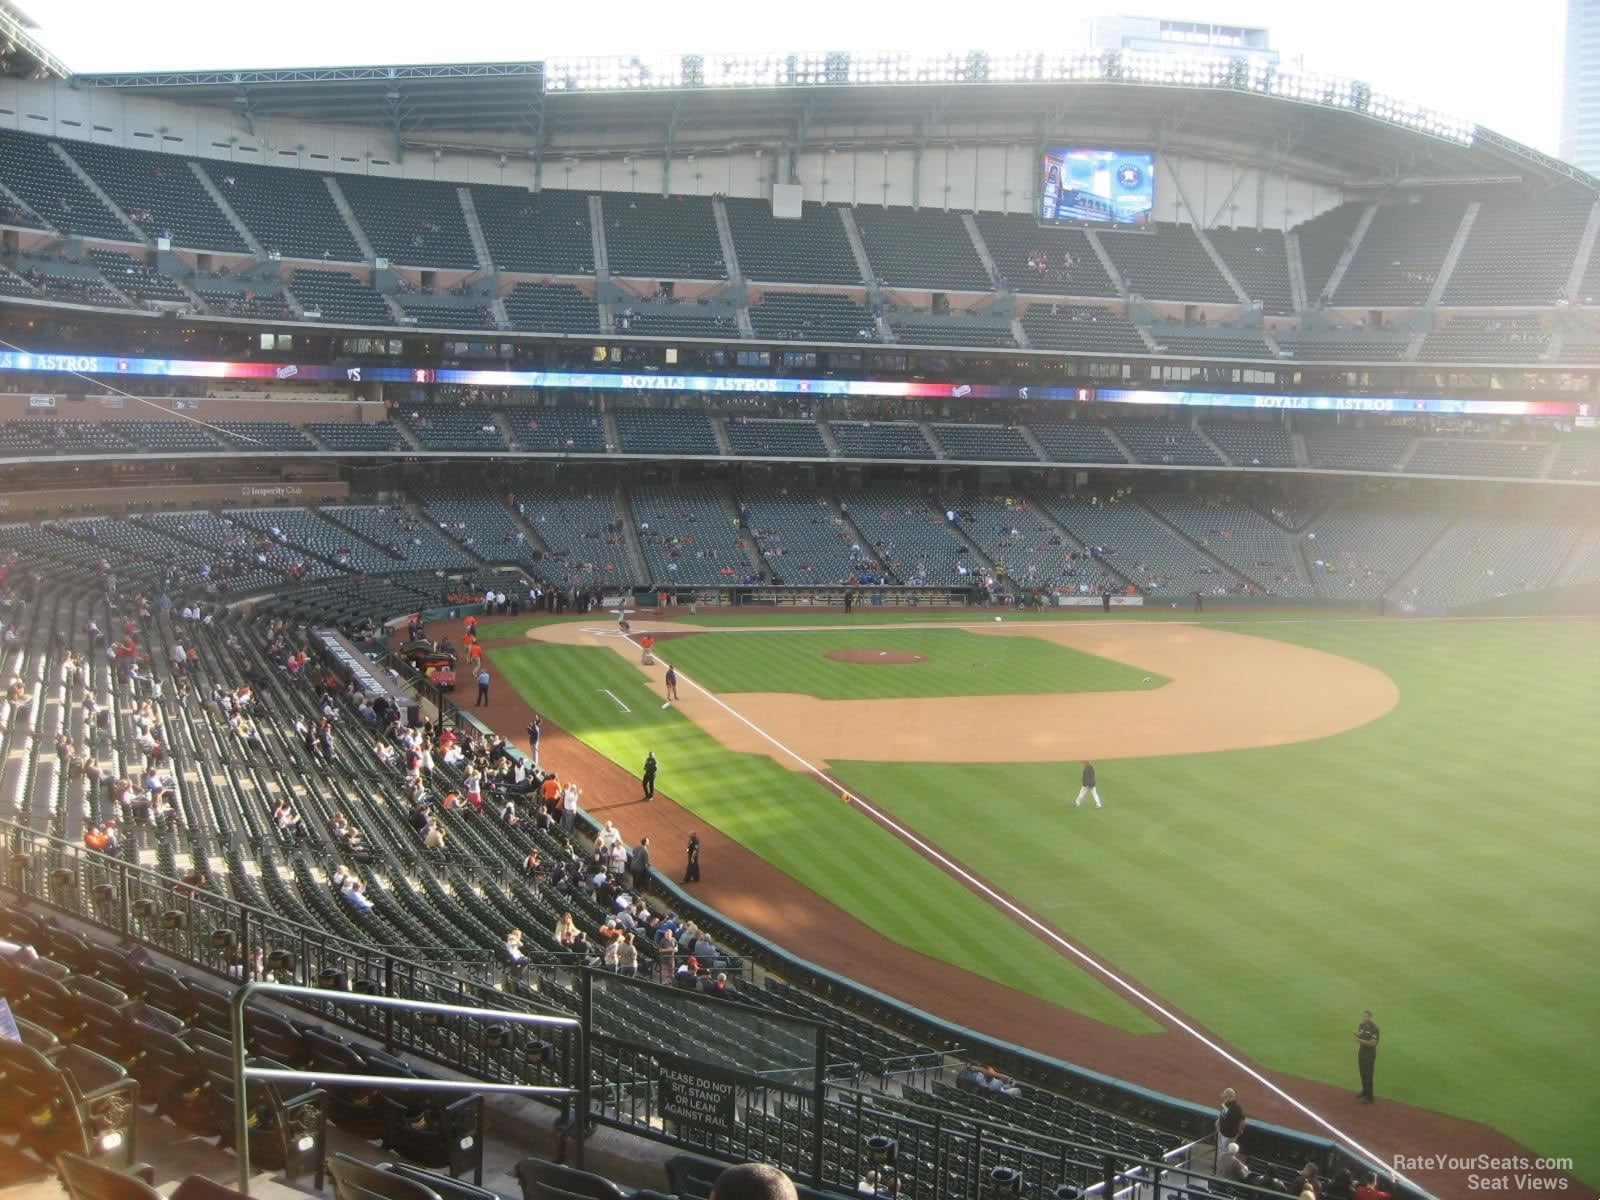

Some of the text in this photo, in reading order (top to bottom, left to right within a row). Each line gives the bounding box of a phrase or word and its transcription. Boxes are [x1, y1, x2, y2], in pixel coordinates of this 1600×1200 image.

[37, 355, 97, 372] ASTROS
[621, 375, 777, 392] ROYALS ASTROS
[1255, 396, 1394, 411] ROYALS ASTROS
[251, 486, 303, 497] Insperity Club
[660, 1067, 732, 1095] PLEASE DO NOT
[675, 1095, 716, 1113] OR LEAN
[688, 1088, 721, 1103] STAND
[664, 1102, 728, 1128] AGAINST RAIL
